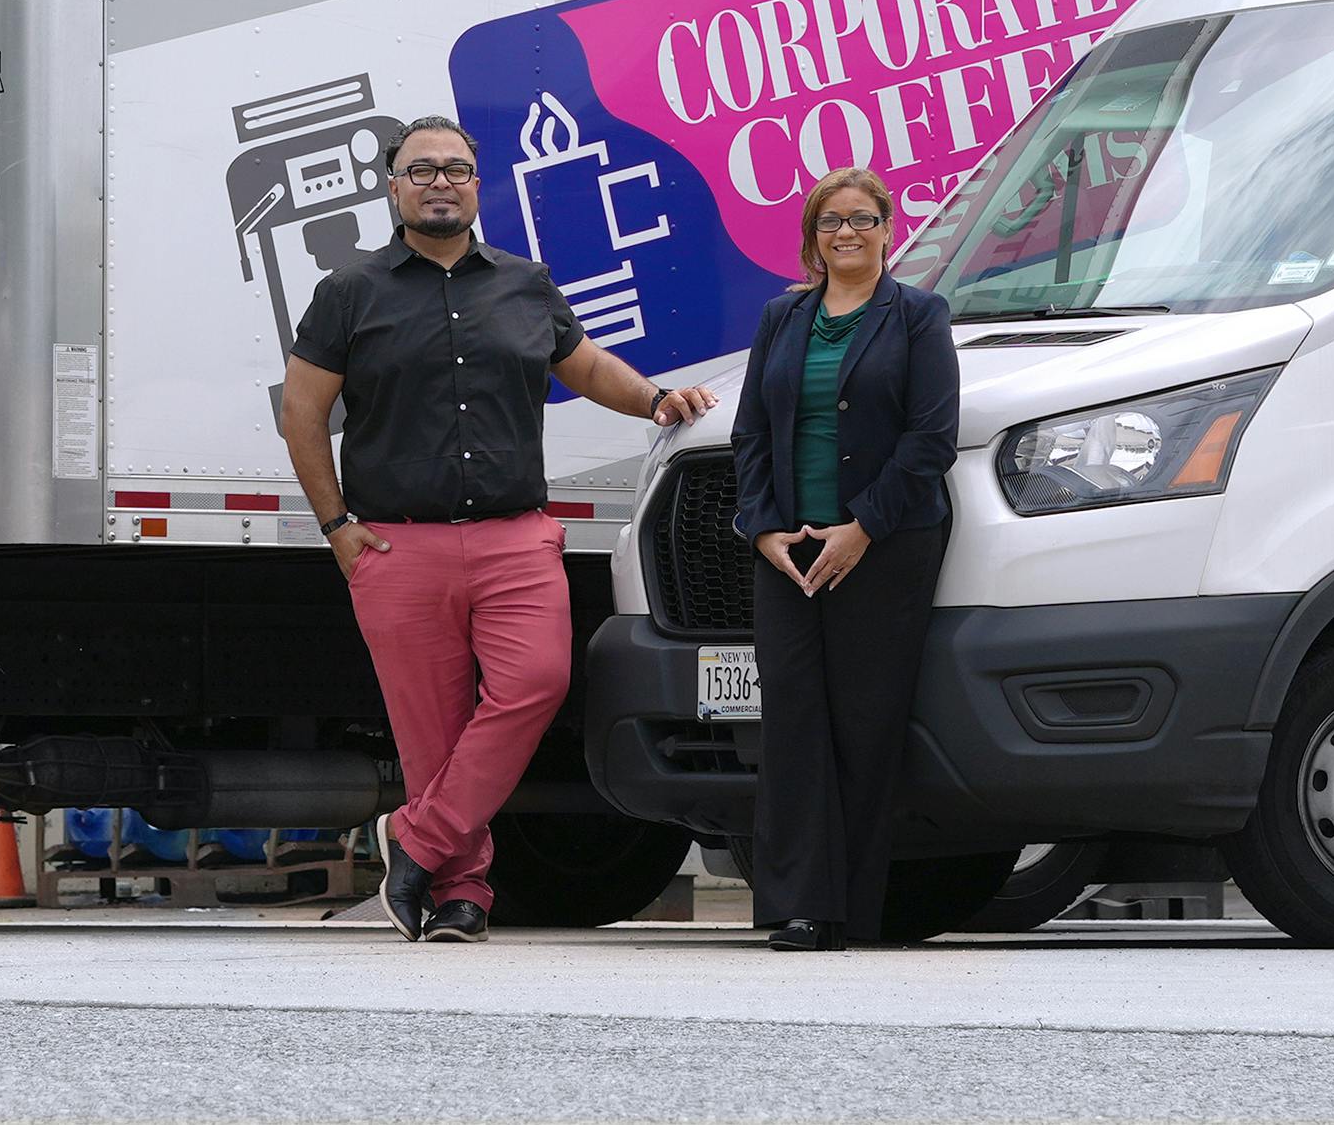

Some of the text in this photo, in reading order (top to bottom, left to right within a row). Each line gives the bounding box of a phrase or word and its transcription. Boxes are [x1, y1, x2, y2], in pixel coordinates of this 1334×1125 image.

[727, 29, 1107, 207] COFFE
[720, 651, 756, 663] NEW YO
[706, 666, 751, 701] 15336
